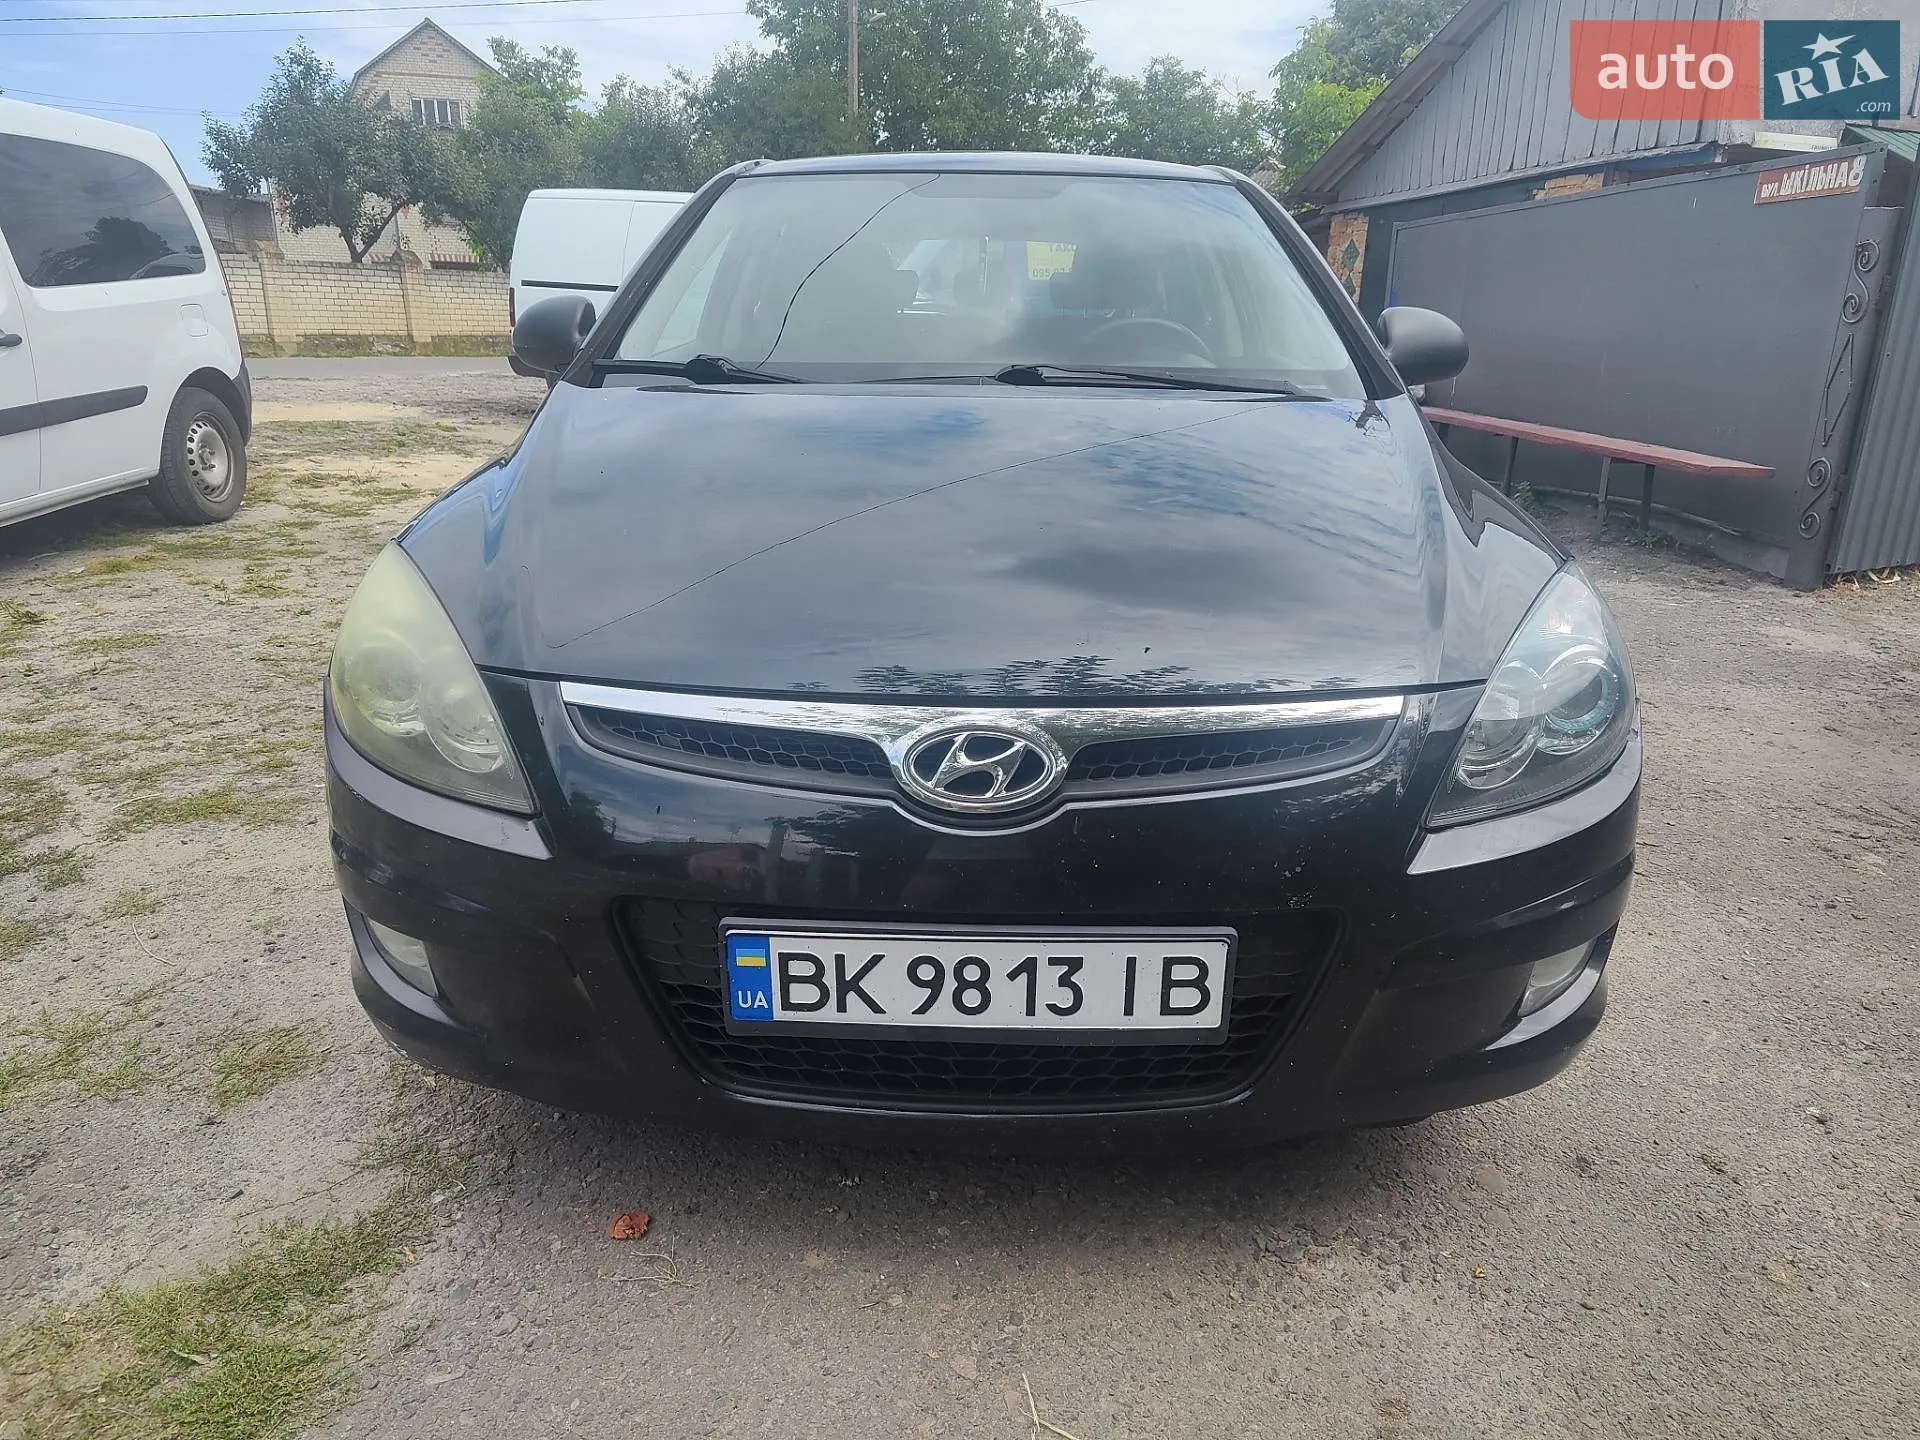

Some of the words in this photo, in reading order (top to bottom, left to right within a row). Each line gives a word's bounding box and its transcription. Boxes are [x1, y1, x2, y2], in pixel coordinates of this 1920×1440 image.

[1849, 155, 1867, 187] 8
[737, 990, 769, 1010] UA
[777, 951, 887, 1015] BK
[906, 954, 1085, 1017] 9813
[1123, 955, 1212, 1017] IB
